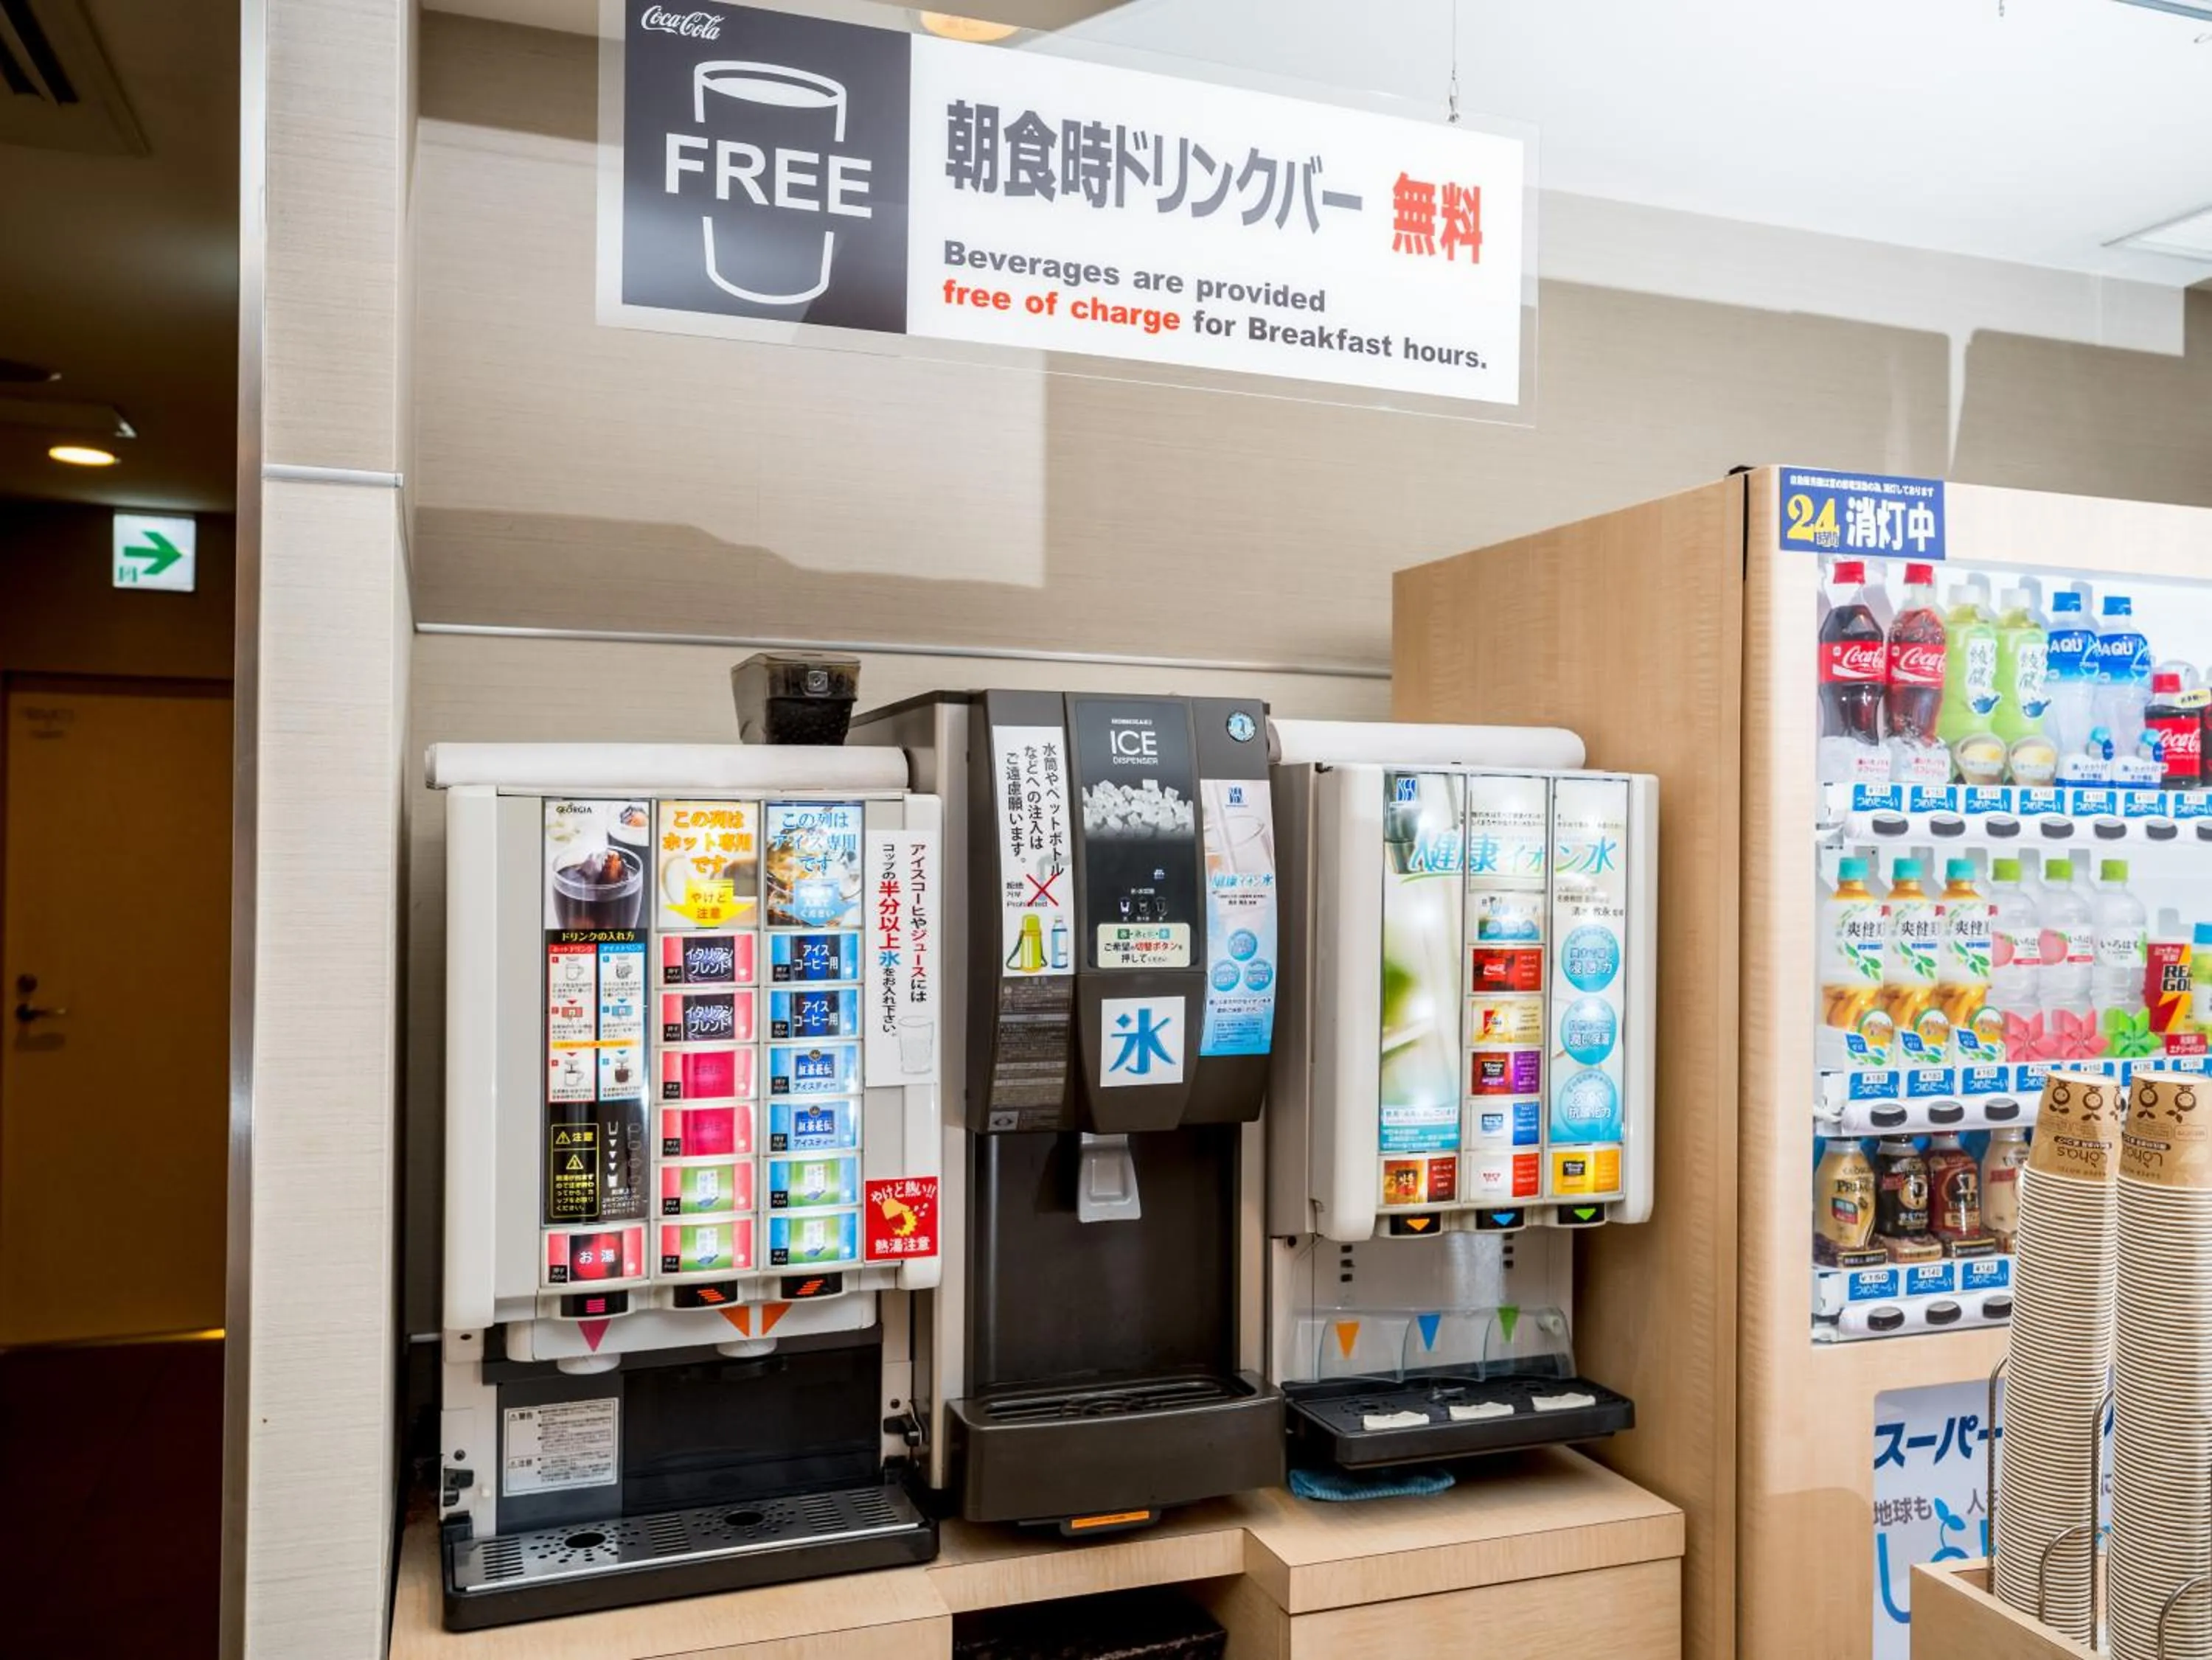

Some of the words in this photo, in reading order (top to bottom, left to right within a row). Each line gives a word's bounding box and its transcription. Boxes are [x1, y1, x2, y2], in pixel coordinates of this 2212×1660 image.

[641, 5, 725, 40] Coca-Cola
[666, 132, 872, 219] FREE
[945, 100, 1363, 234] 朝食時ドリンクバー
[1392, 171, 1483, 264] 無料
[944, 240, 1120, 286] Beverages
[1133, 269, 1183, 293] are
[1195, 278, 1326, 313] provided
[943, 279, 1011, 310] free
[1025, 293, 1058, 316] of
[1071, 296, 1181, 334] charge
[1193, 310, 1236, 340] for
[1248, 318, 1393, 358] Breakfast
[1403, 338, 1489, 370] hours.
[1787, 493, 1840, 543] 24
[1846, 496, 1935, 552] 消灯中
[1110, 730, 1158, 756] ICE
[1113, 756, 1158, 765] DISPENSER
[1024, 745, 1043, 850] などへの注入は
[1006, 752, 1026, 863] ご遠慮願います。
[1042, 743, 1064, 876] 水筒やペットボトル
[672, 810, 745, 829] この列は
[783, 812, 850, 829] この列は
[691, 855, 728, 874] です
[799, 856, 832, 873] です
[691, 893, 726, 904] やけど
[562, 931, 635, 942] ドリンクの入れ方
[686, 947, 734, 960] イタリアン
[802, 944, 830, 958] アイス
[793, 956, 838, 971] コーヒー用
[686, 1005, 734, 1018] イタリアン
[802, 1000, 830, 1014] アイス
[793, 1012, 838, 1027] コーヒー用
[1108, 1008, 1177, 1075] 氷
[794, 1082, 836, 1091] アイスティー
[794, 1138, 836, 1148] アイスティー
[579, 1249, 615, 1264] お湯
[1874, 1496, 1933, 1527] 地球も
